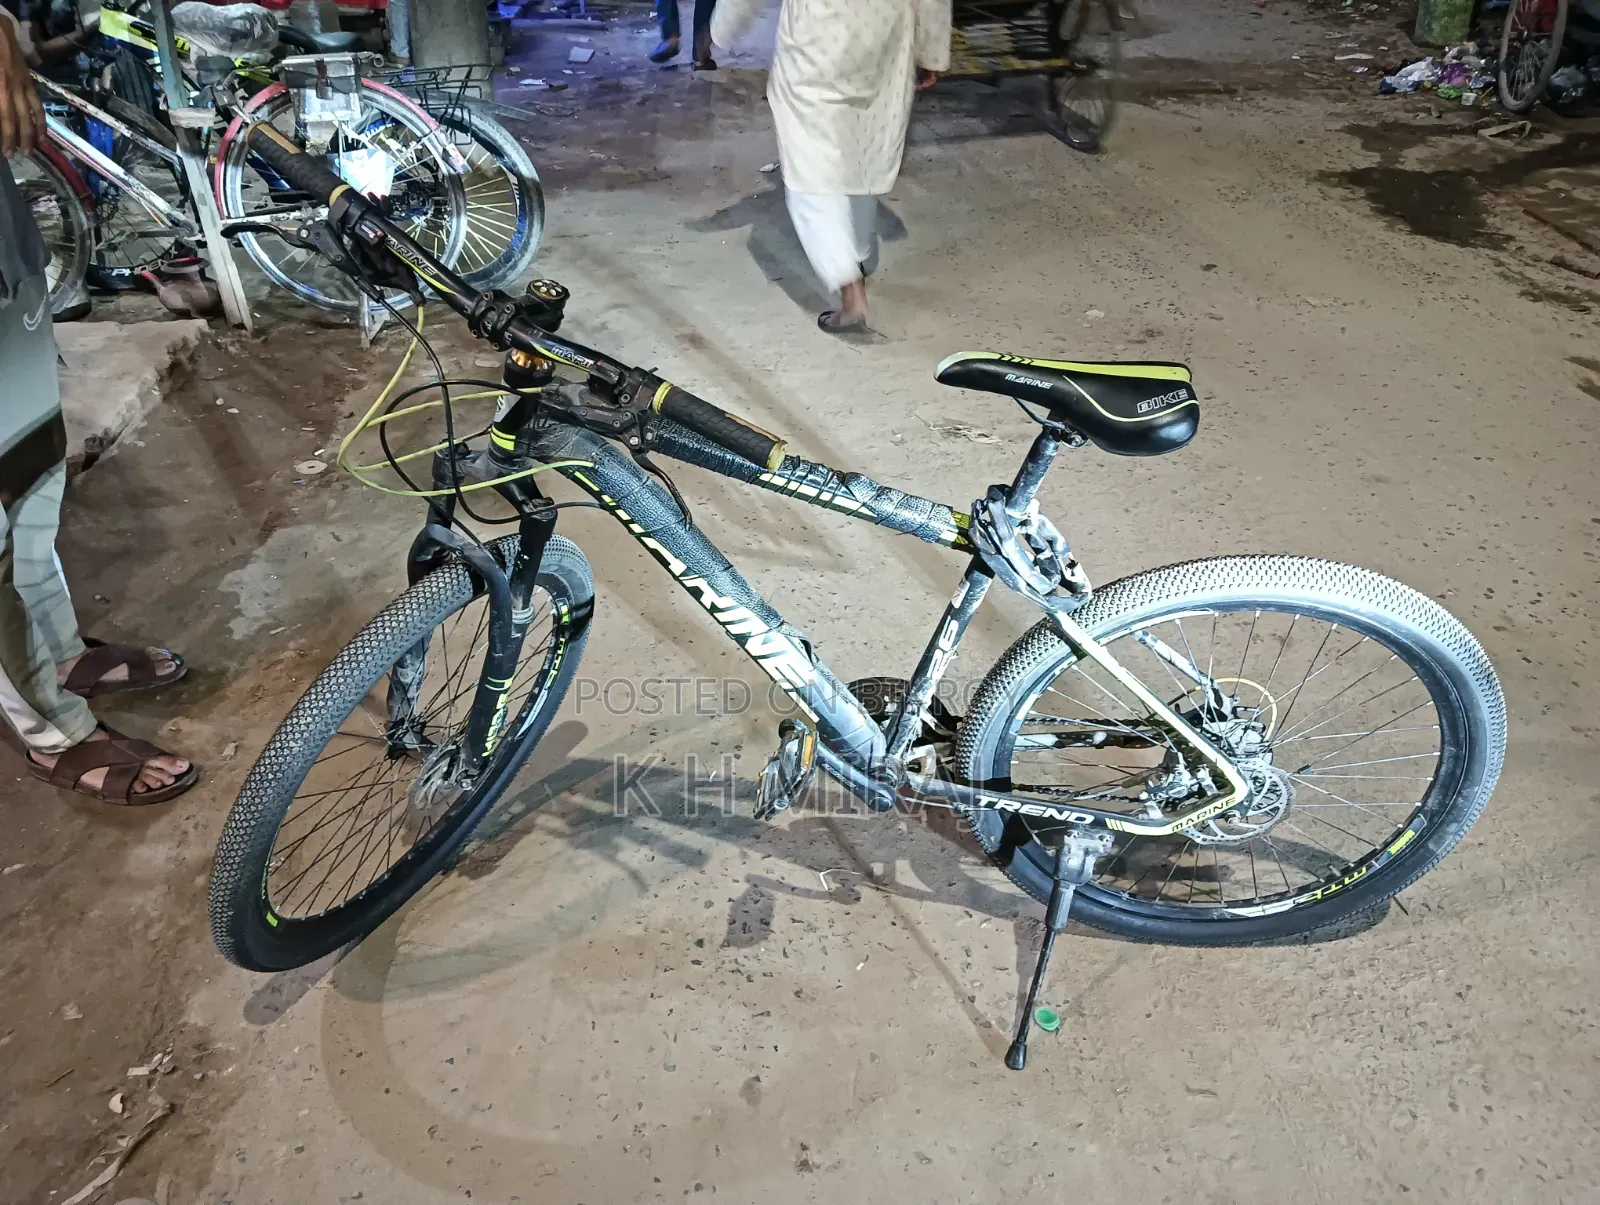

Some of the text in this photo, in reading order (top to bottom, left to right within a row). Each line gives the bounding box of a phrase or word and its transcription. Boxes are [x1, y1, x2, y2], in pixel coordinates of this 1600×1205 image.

[386, 234, 439, 277] ARINE
[1004, 373, 1054, 390] MARINE
[1136, 388, 1190, 414] BIKE
[974, 795, 1096, 826] TREND
[1171, 797, 1238, 833] MARINE
